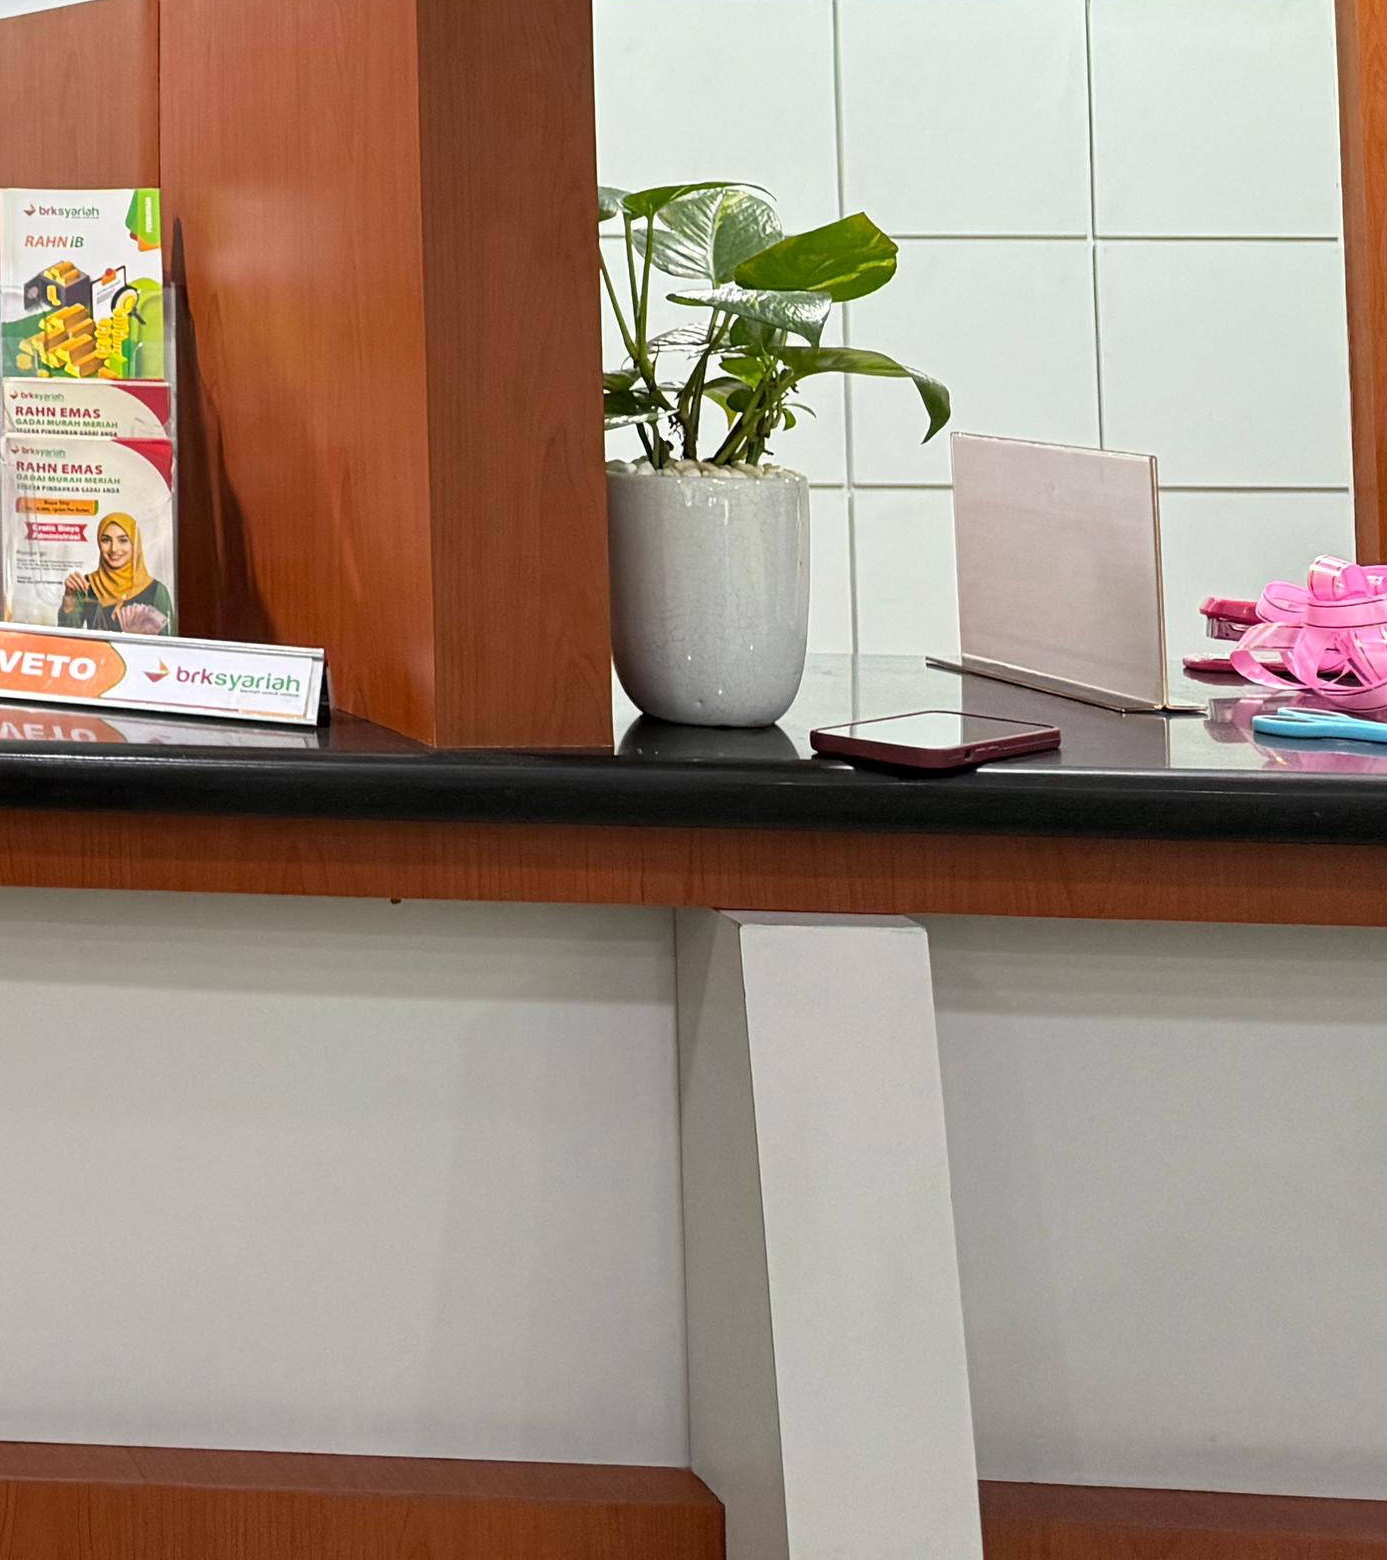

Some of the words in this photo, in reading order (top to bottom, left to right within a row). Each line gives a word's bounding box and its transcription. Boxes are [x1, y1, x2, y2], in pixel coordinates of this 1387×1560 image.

[38, 206, 100, 218] brksyariah
[24, 236, 68, 248] RAHN
[15, 406, 56, 418] RAHN
[60, 407, 101, 419] EMAS
[15, 418, 45, 426] GADAI
[46, 419, 80, 427] MURAH
[83, 420, 118, 429] MERIAH
[16, 461, 57, 474] RAHN
[62, 463, 103, 475] EMAS
[84, 476, 120, 484] MERIAH
[176, 665, 300, 692] brksyariah
